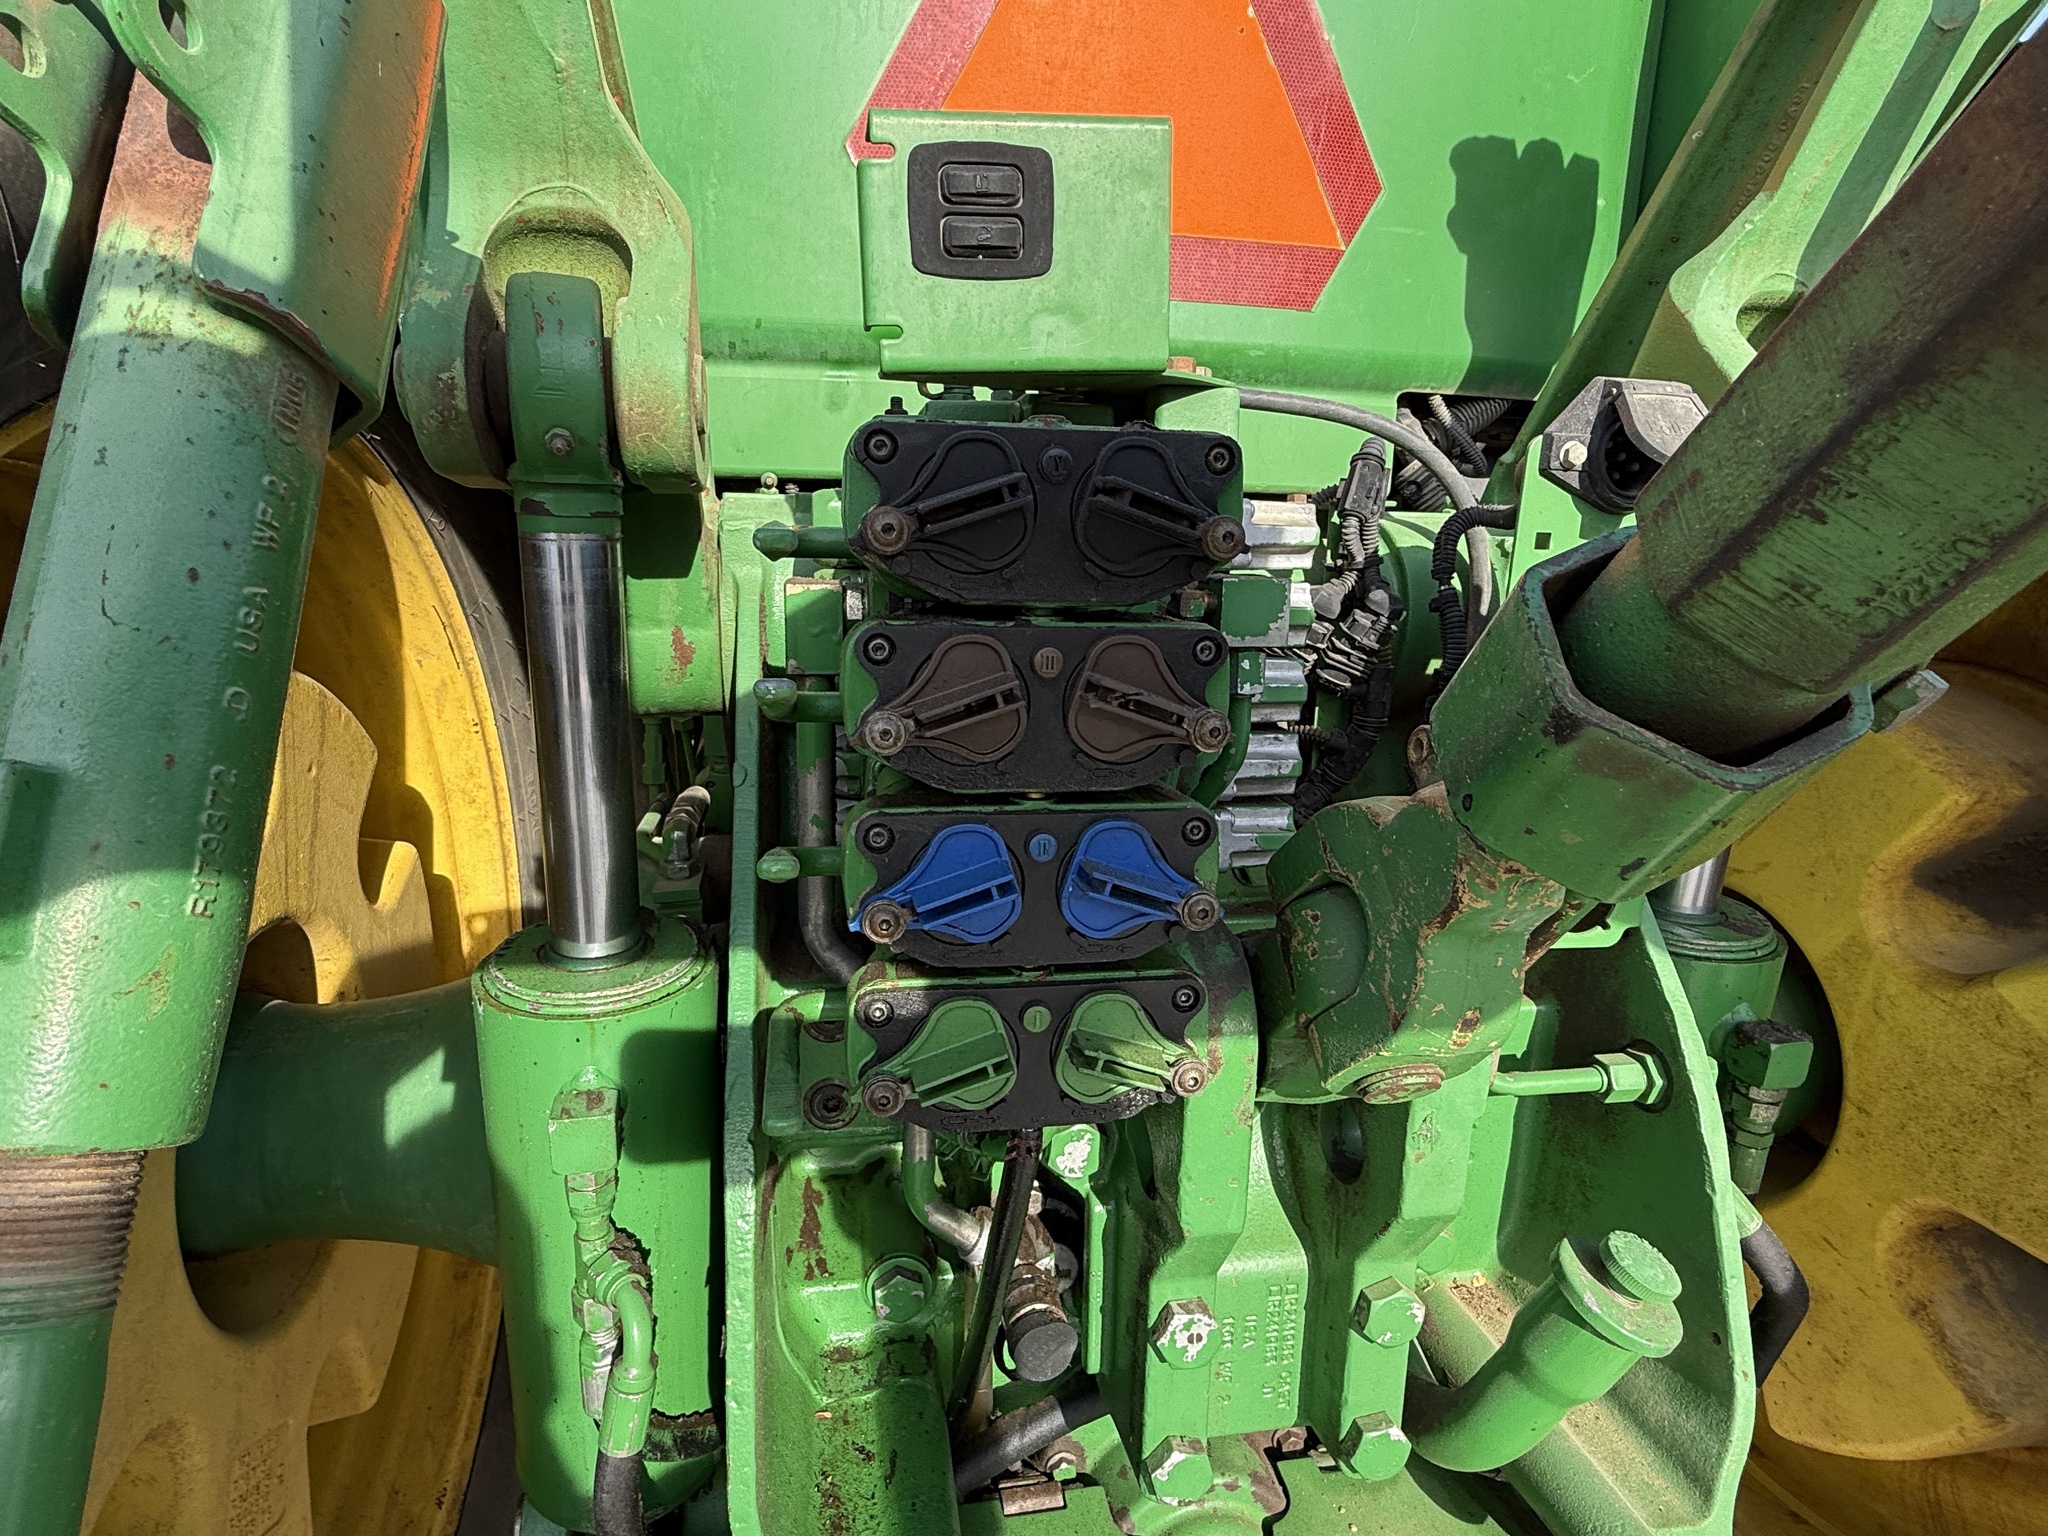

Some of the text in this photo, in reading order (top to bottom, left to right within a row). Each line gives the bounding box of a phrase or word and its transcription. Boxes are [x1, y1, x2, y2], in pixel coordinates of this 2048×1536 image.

[233, 586, 268, 653] USA
[1039, 653, 1057, 672] III
[1242, 1314, 1258, 1349] USA
